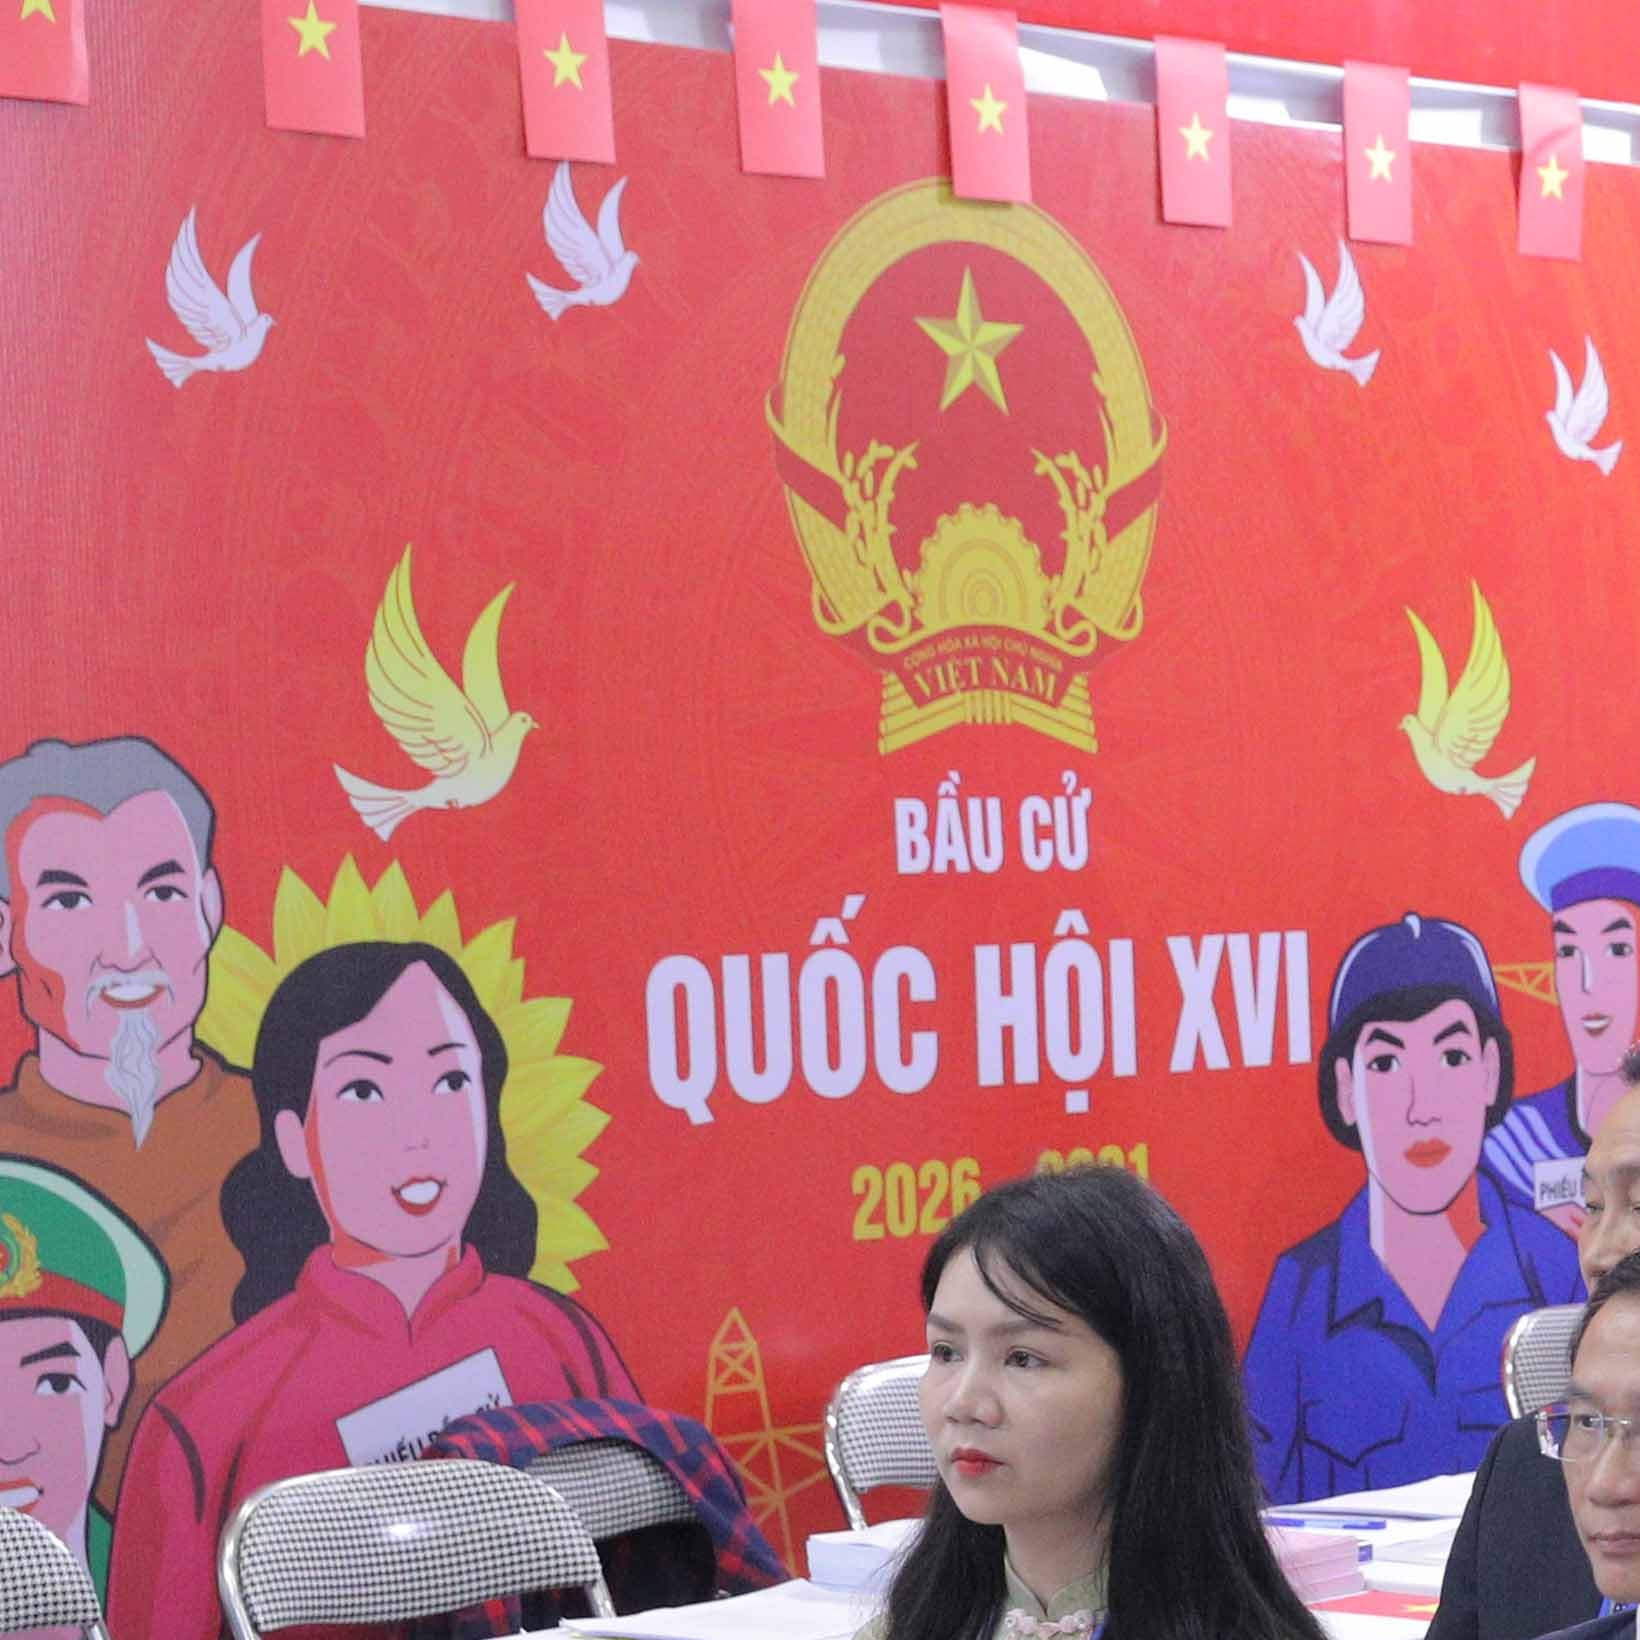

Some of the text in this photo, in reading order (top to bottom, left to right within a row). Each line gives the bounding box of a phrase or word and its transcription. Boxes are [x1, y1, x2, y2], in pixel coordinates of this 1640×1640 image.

[913, 655, 1057, 701] VIỆT NAM
[893, 769, 1093, 875] BẦU CỬ
[645, 894, 1313, 1126] QUỐC HỘI XVI
[851, 1156, 983, 1241] 2026
[1539, 1176, 1578, 1201] PHIẾU
